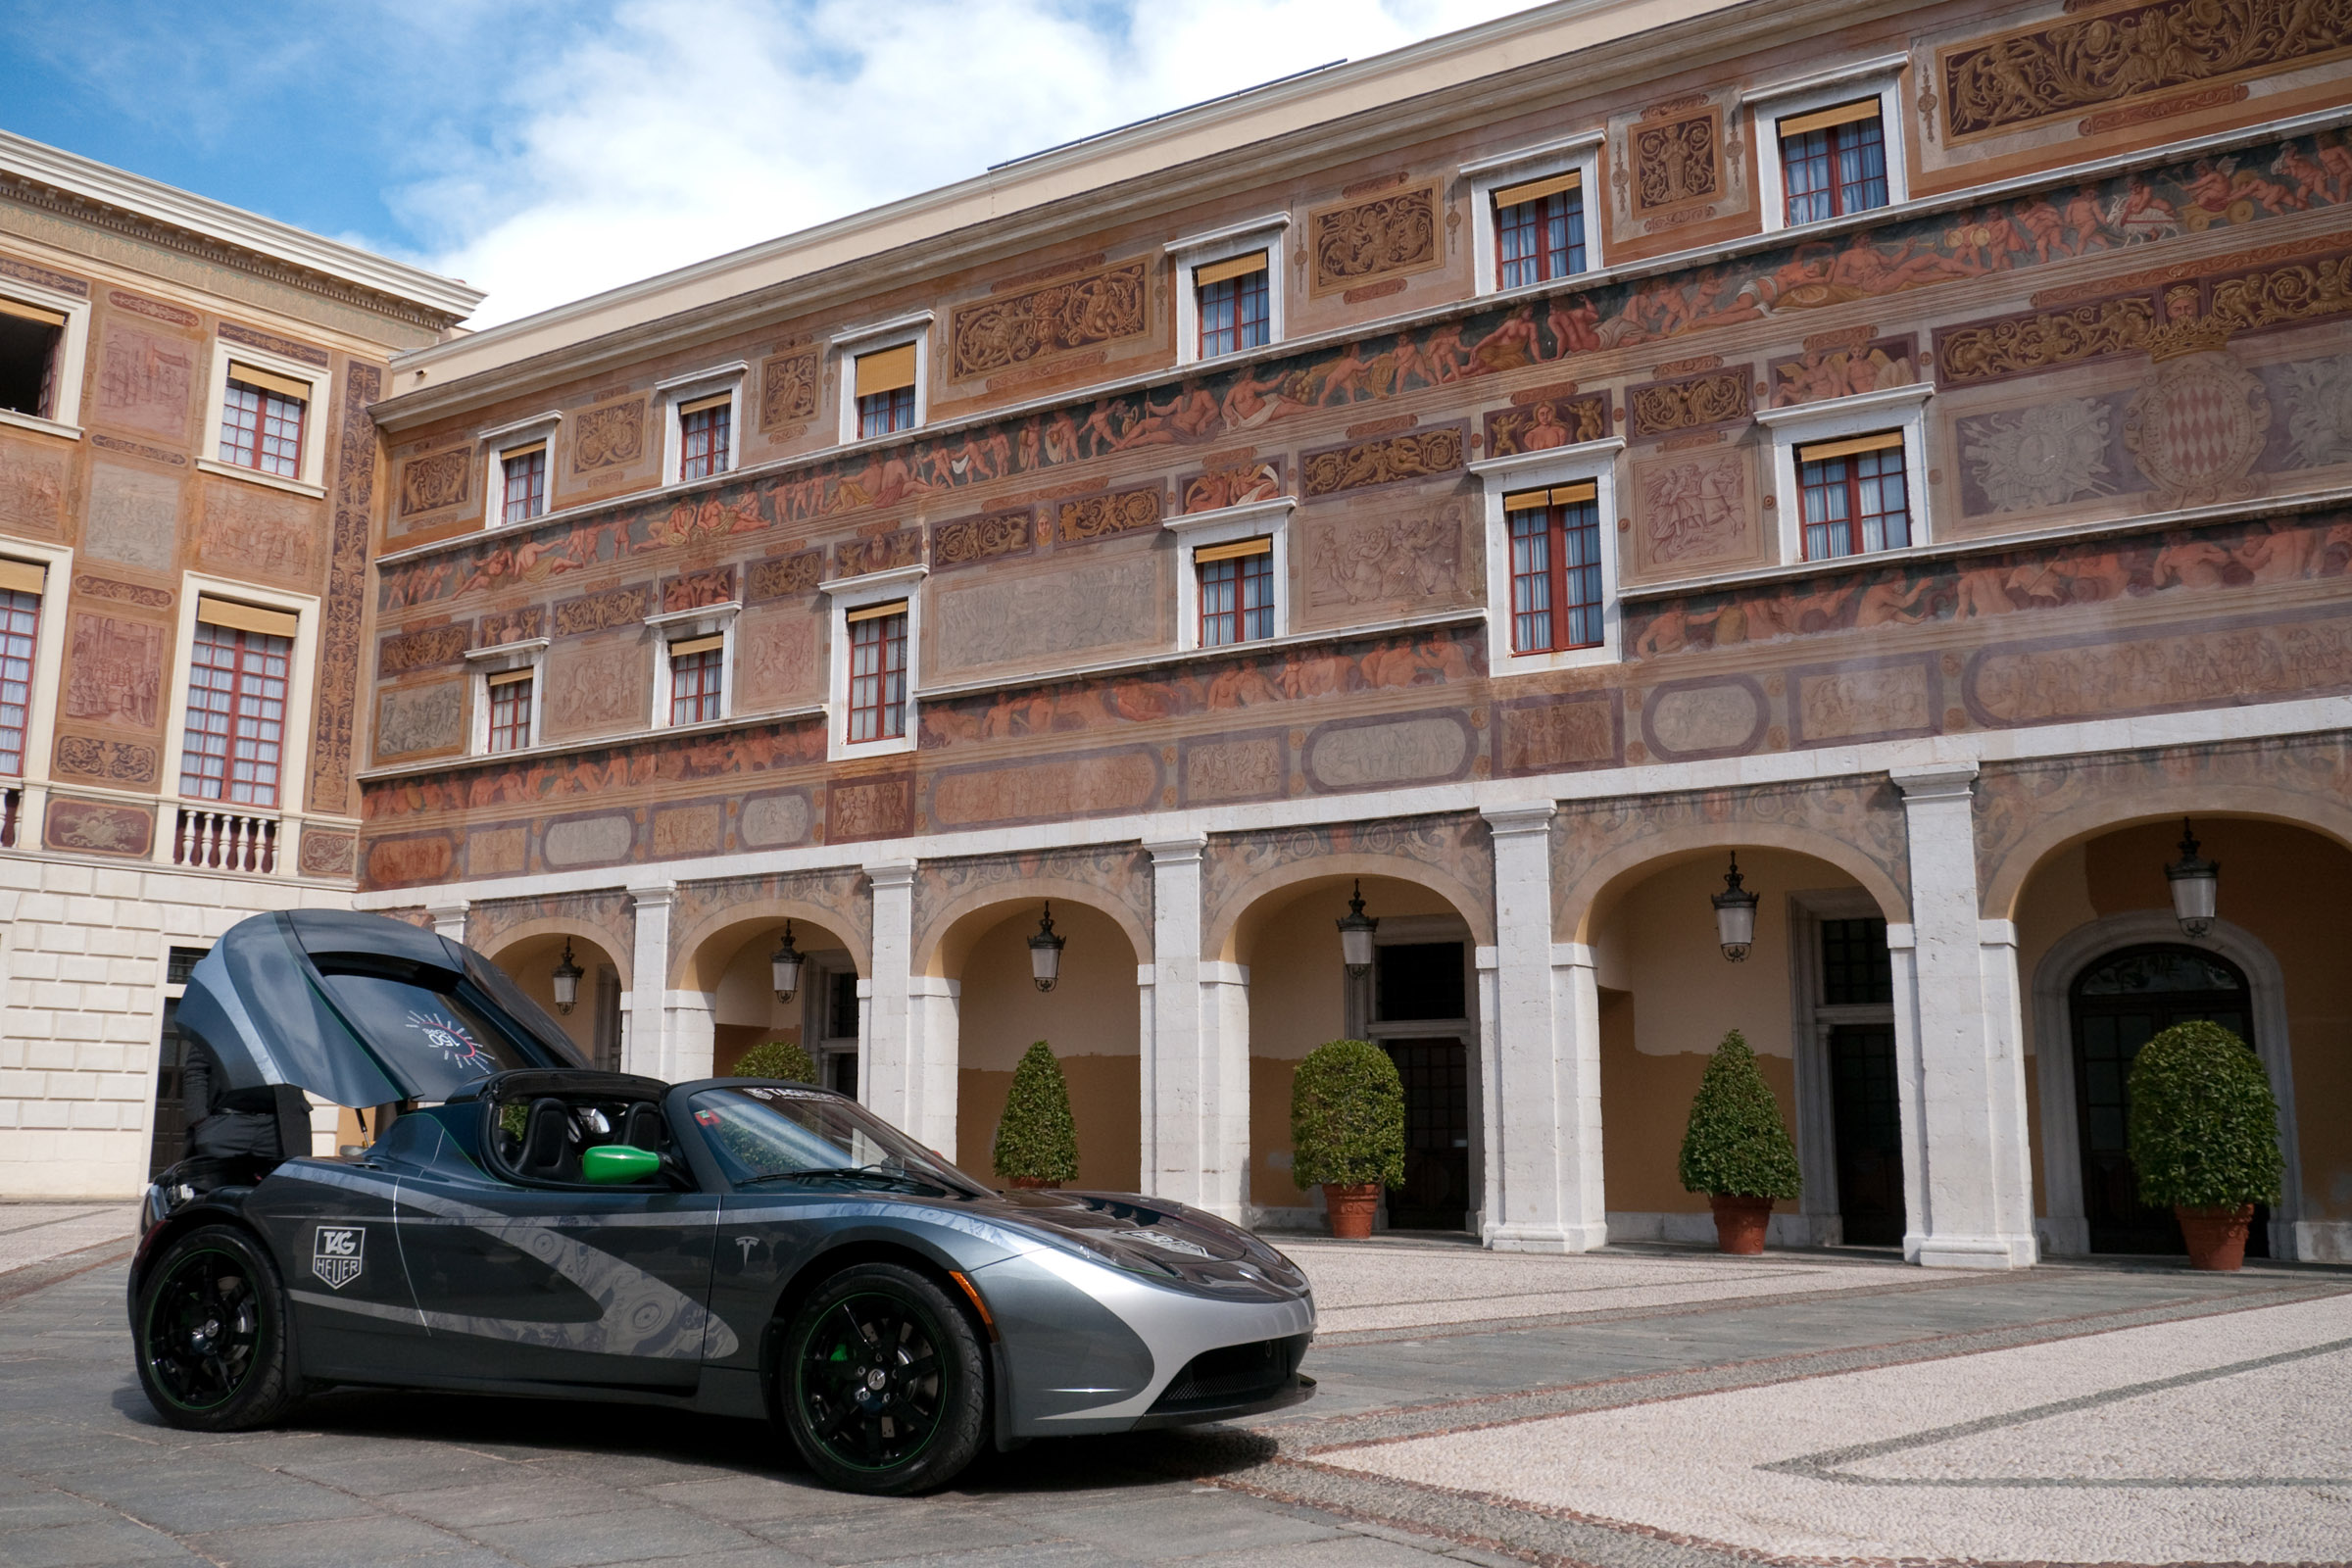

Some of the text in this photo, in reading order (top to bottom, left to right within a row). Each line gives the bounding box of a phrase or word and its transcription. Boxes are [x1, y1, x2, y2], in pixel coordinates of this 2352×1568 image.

[428, 1033, 461, 1048] 150
[323, 1230, 357, 1255] TAG
[316, 1258, 359, 1285] HEUER
